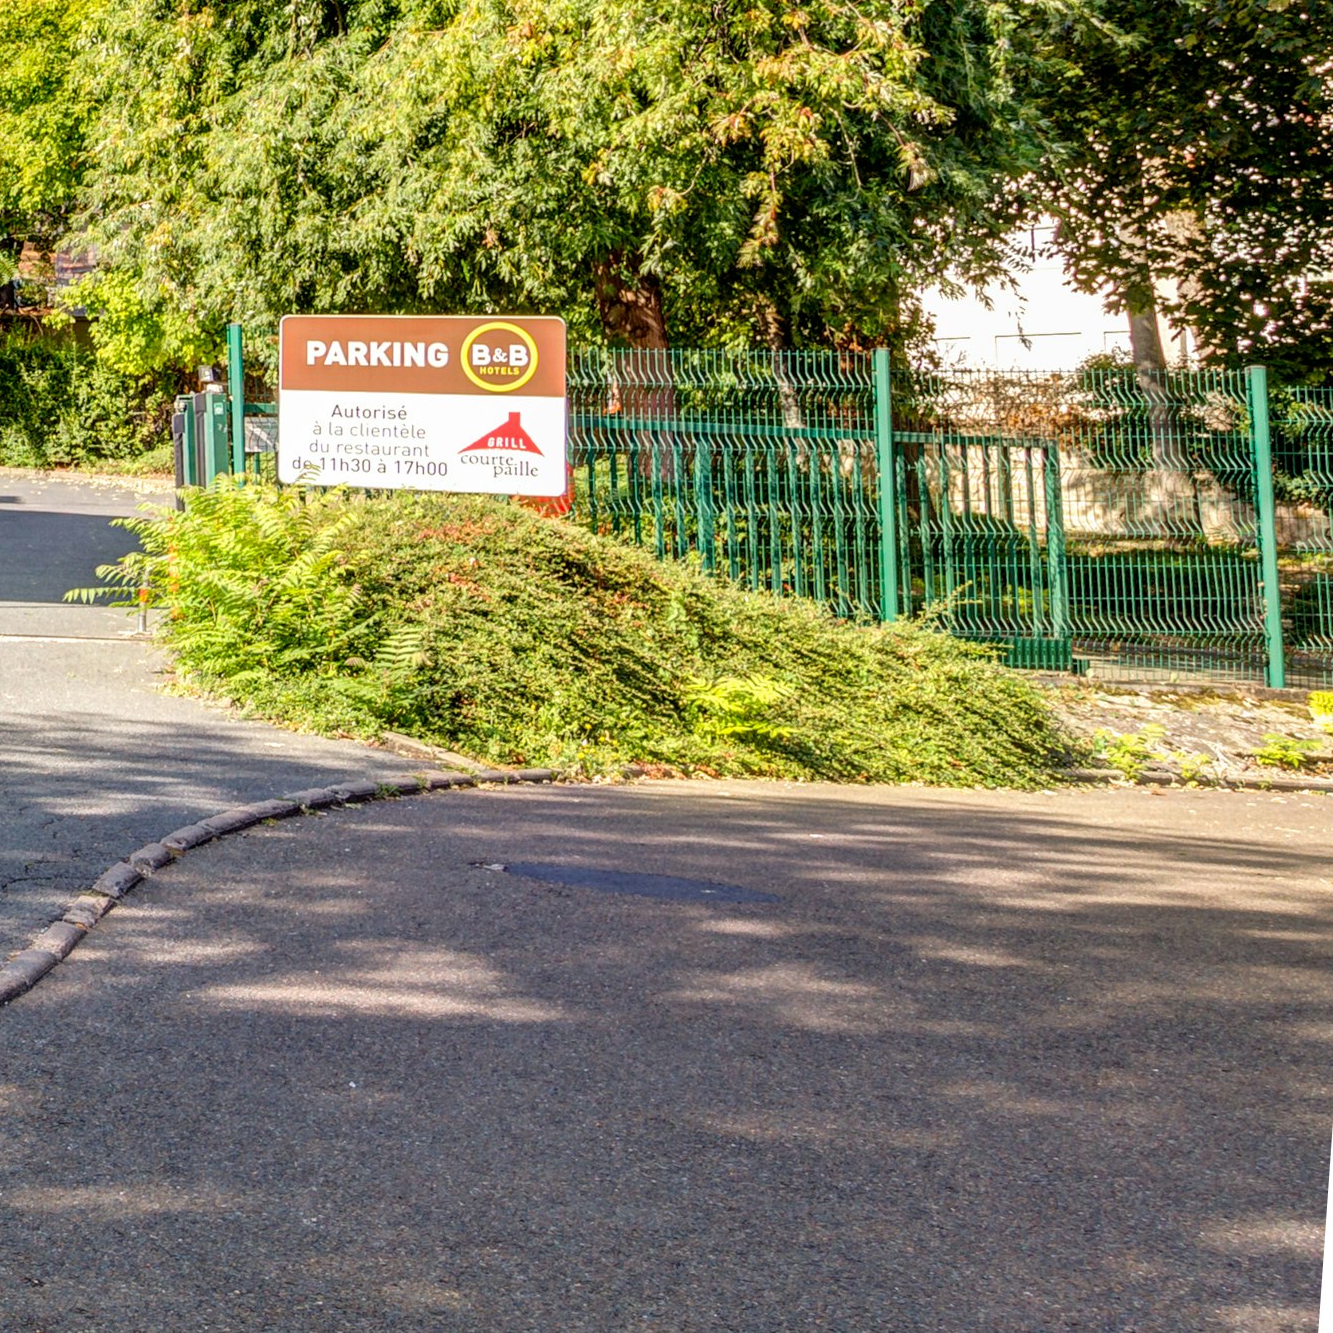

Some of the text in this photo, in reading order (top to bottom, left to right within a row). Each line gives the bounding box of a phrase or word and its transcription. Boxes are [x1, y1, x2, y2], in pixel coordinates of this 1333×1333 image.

[306, 340, 449, 368] PARKING
[472, 344, 529, 367] B&B
[479, 366, 520, 376] HOTELS
[331, 404, 408, 420] Autorisé
[312, 420, 427, 439] à la clientèle
[309, 439, 430, 458] du restaurant
[487, 437, 527, 449] GRILL
[319, 457, 371, 473] 11h30
[377, 459, 387, 474] à
[394, 460, 448, 477] 17h00
[460, 454, 514, 466] courte
[493, 461, 539, 478] paille
